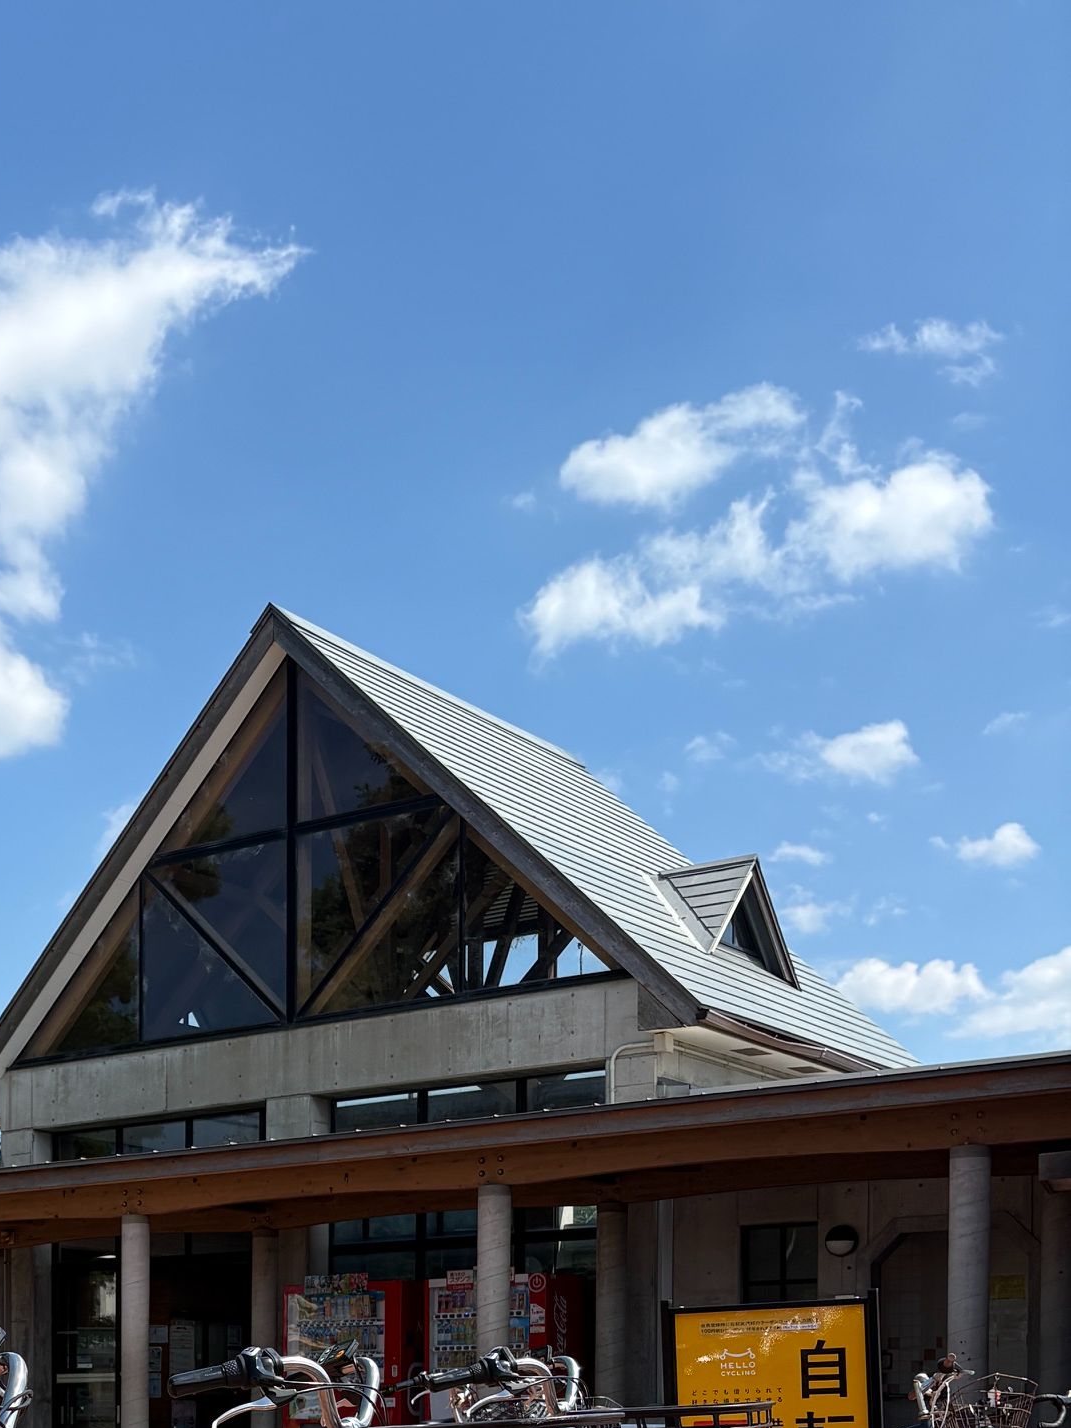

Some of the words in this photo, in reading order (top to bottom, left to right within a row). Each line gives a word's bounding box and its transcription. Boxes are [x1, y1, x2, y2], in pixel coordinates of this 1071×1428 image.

[720, 1361, 756, 1369] HELLO
[720, 1369, 756, 1377] CYCLING
[691, 1387, 783, 1396] どこでも借りられて
